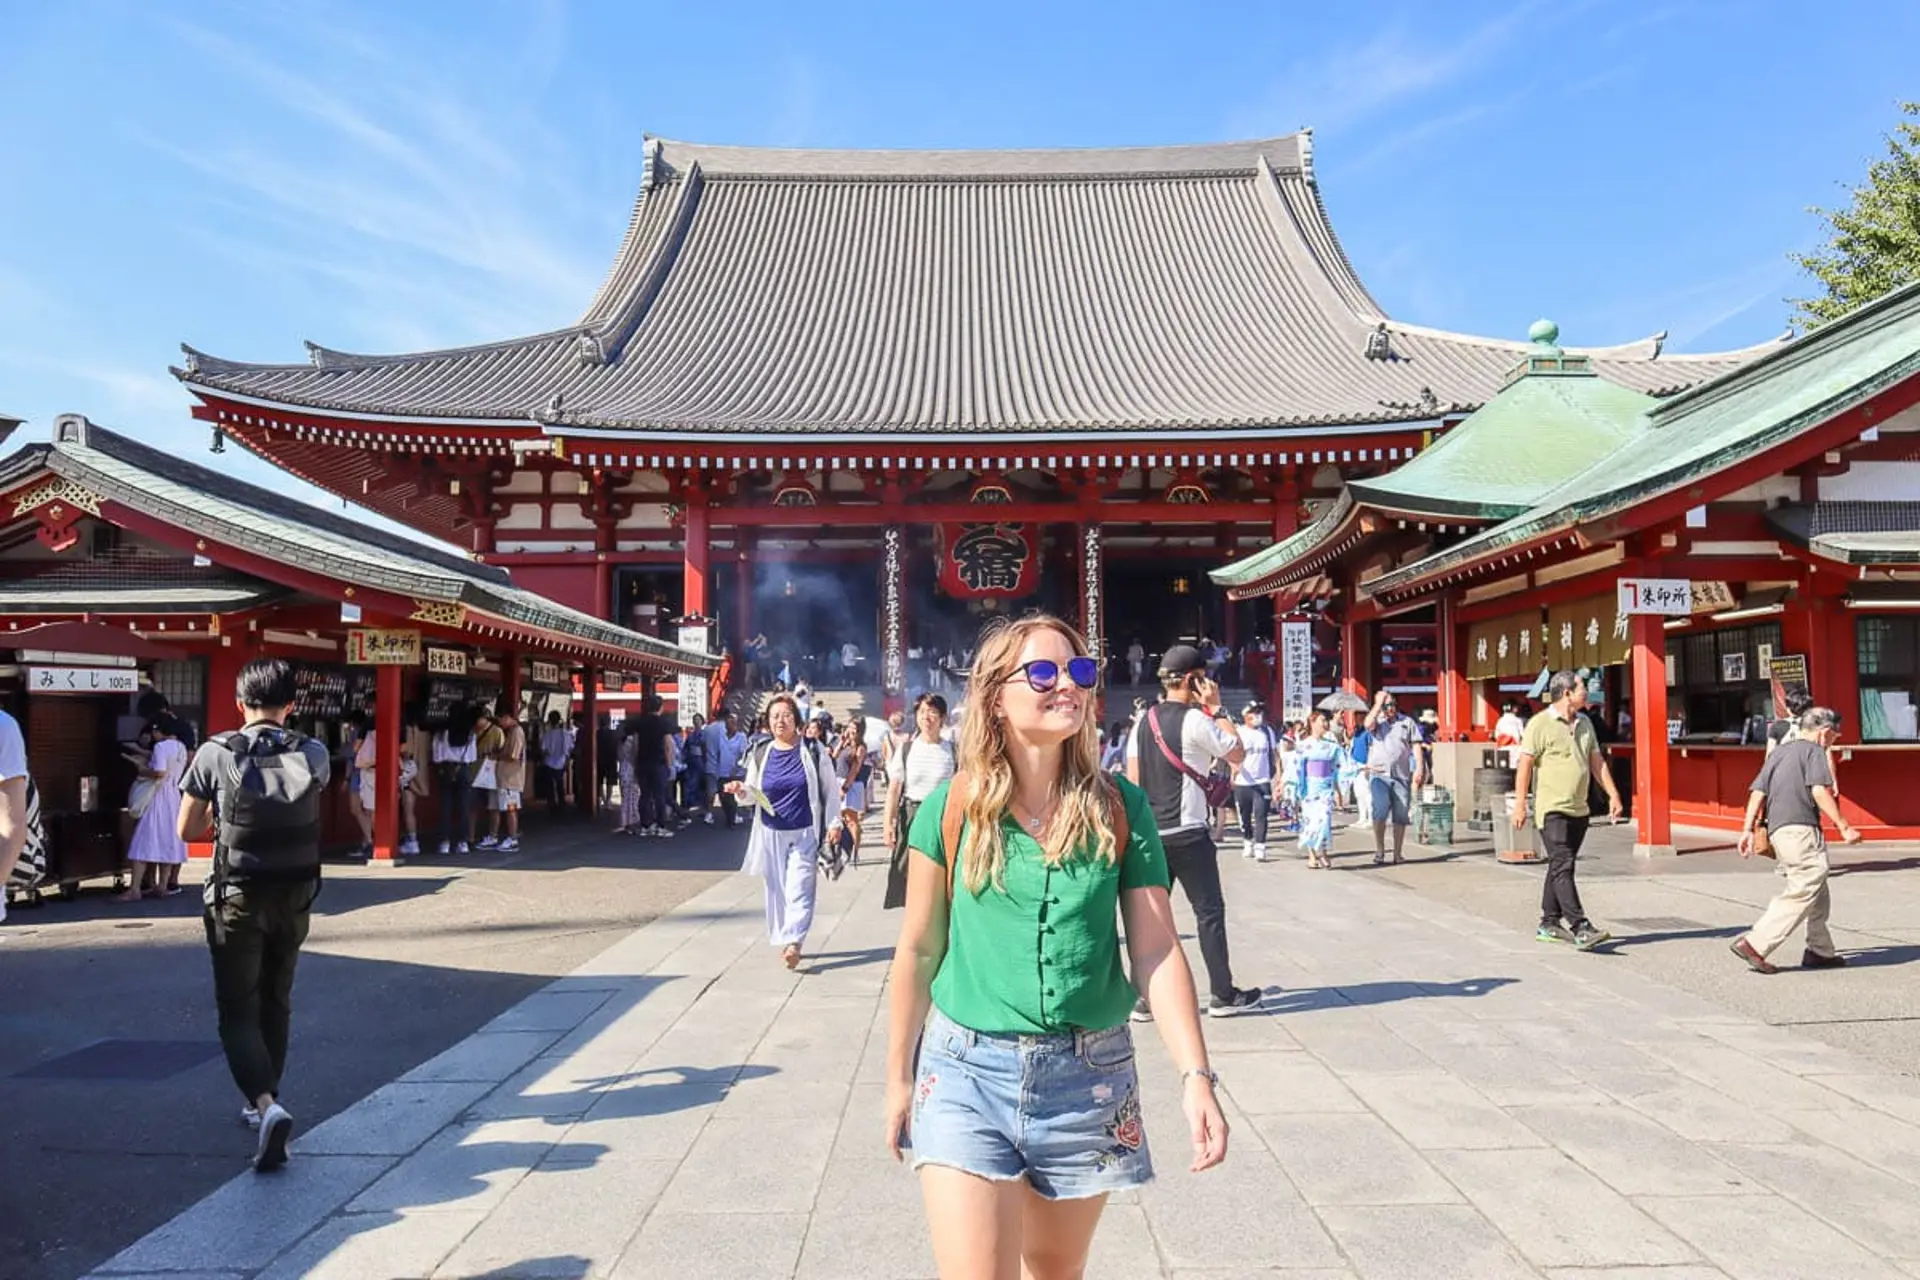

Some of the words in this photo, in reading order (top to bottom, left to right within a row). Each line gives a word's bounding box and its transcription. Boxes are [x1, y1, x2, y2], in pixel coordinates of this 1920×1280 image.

[1642, 586, 1687, 607] 朱印所
[367, 634, 416, 652] 朱印所
[40, 671, 100, 689] みくじ
[109, 676, 132, 689] 100円
